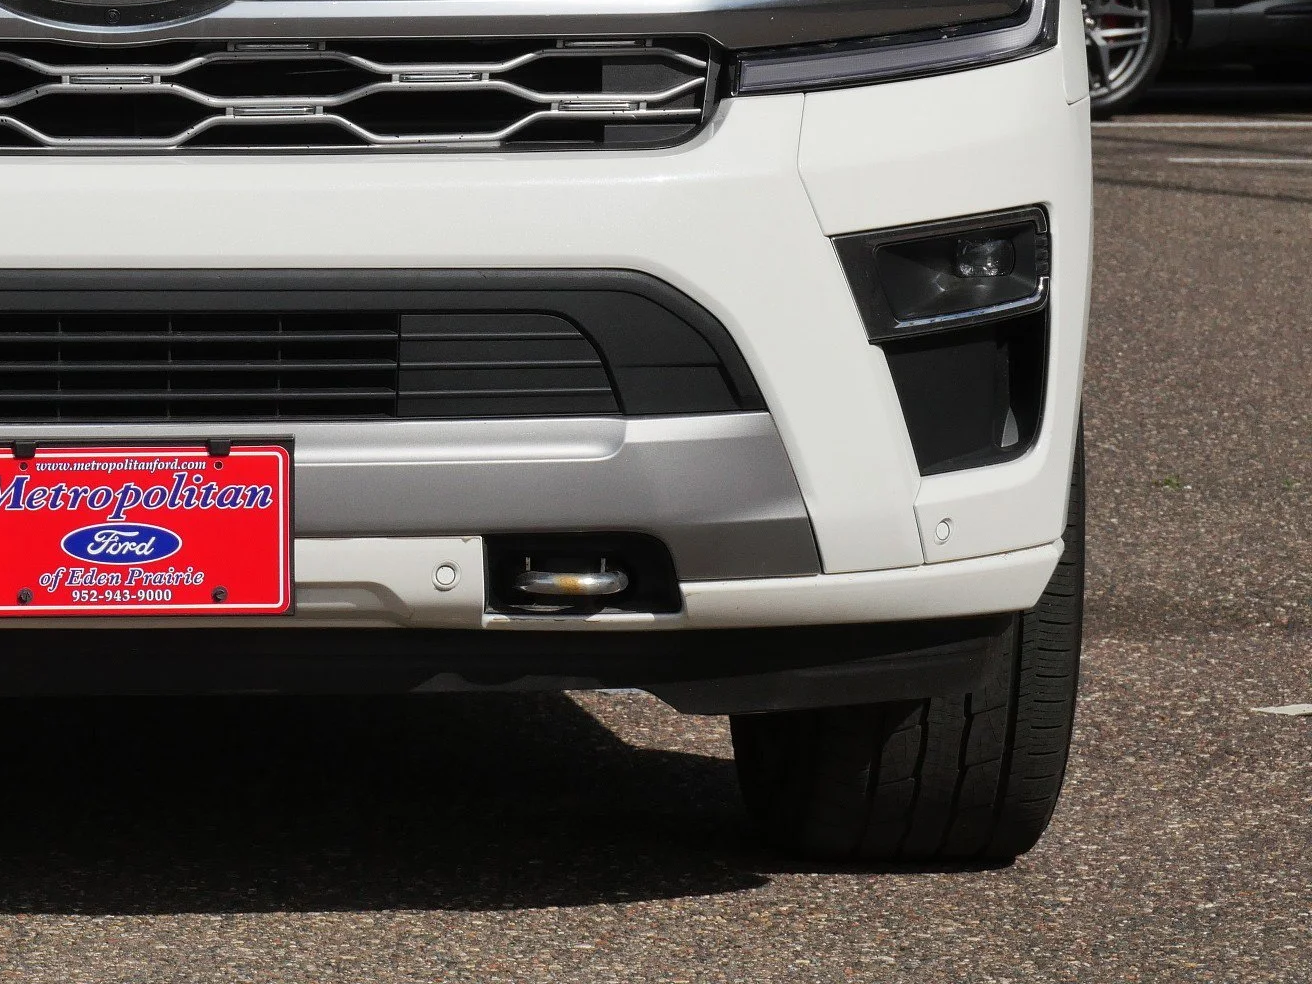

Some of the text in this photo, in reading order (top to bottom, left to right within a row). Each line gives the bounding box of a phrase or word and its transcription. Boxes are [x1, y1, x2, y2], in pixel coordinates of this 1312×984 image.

[35, 458, 207, 474] www.metropolitanford.com
[86, 529, 156, 556] Ford
[38, 567, 205, 592] of Eden Prairie
[71, 589, 173, 603] 952-943-9000
